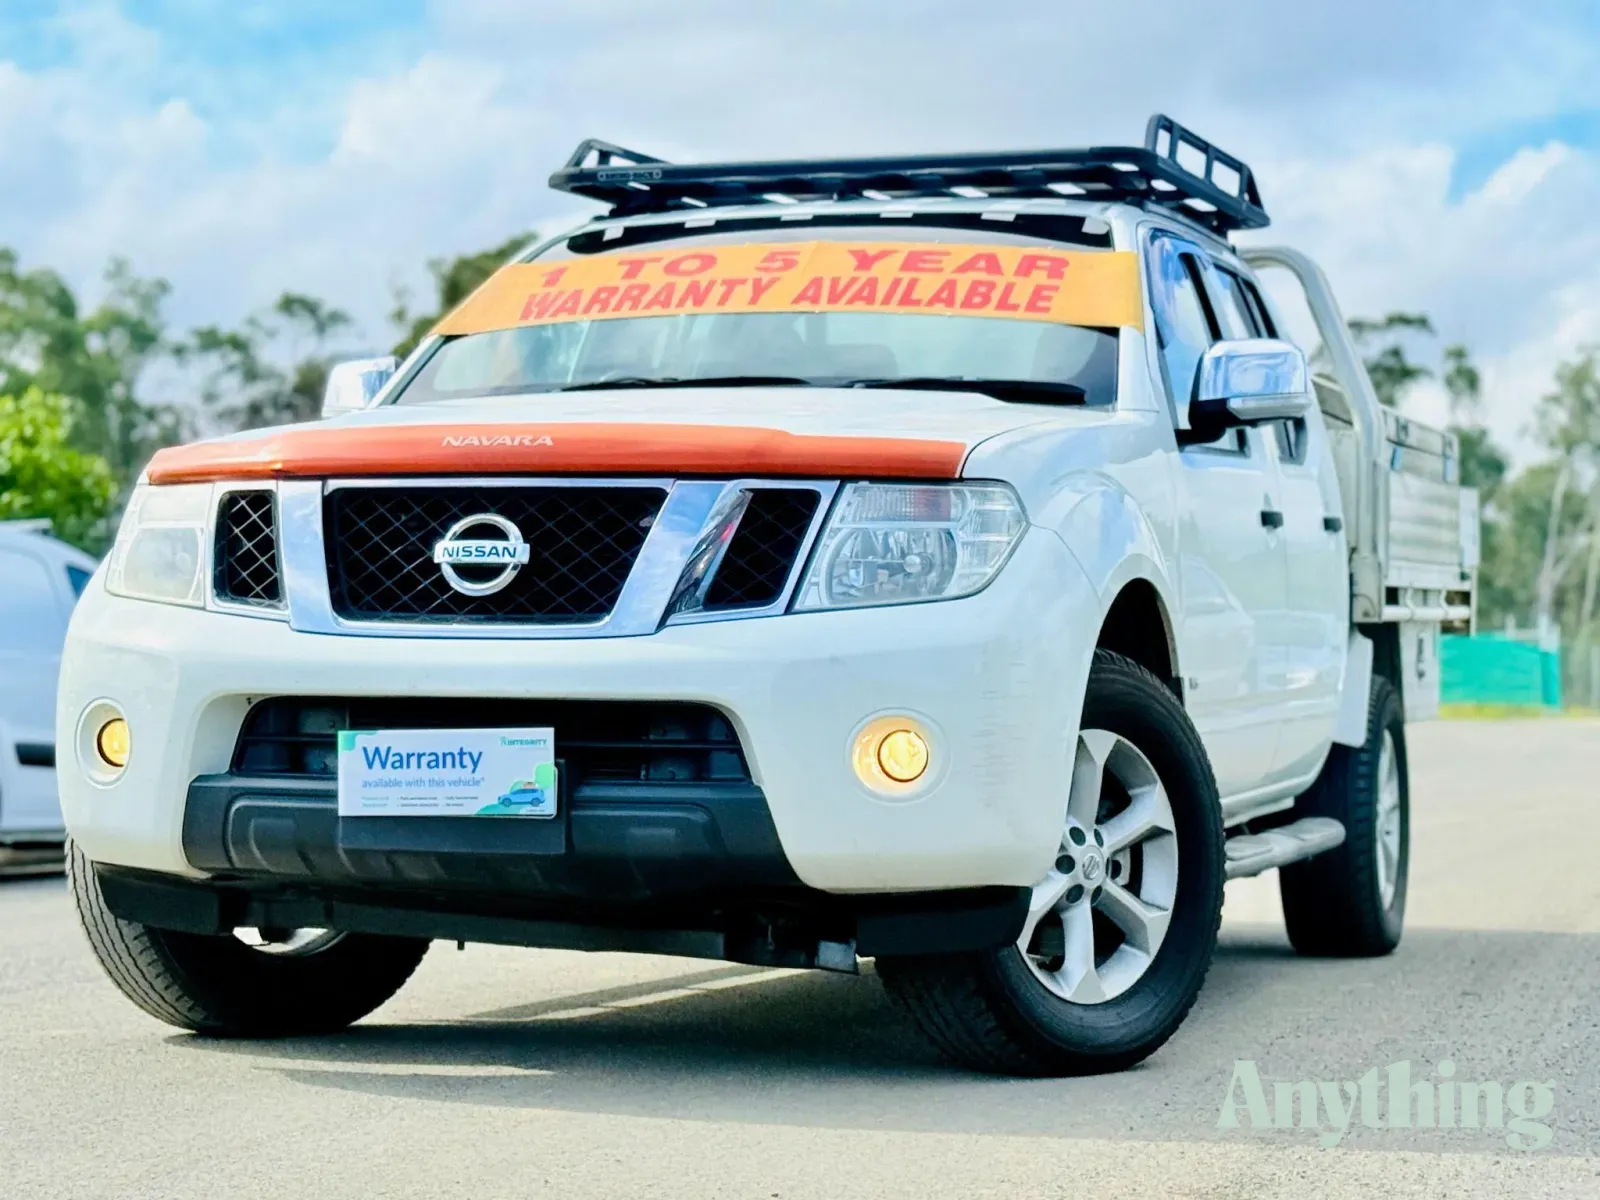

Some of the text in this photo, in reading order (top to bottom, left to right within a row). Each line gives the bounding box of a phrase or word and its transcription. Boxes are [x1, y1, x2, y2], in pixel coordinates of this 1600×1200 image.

[540, 249, 1070, 288] 1 TO 5 YEAR
[519, 276, 1060, 321] WARRANTY AVAILABLE
[441, 435, 554, 447] NAVARA
[442, 546, 517, 559] NISSAN
[361, 745, 483, 773] Warranty
[362, 777, 402, 789] available
[405, 777, 425, 788] with
[428, 777, 445, 788] this
